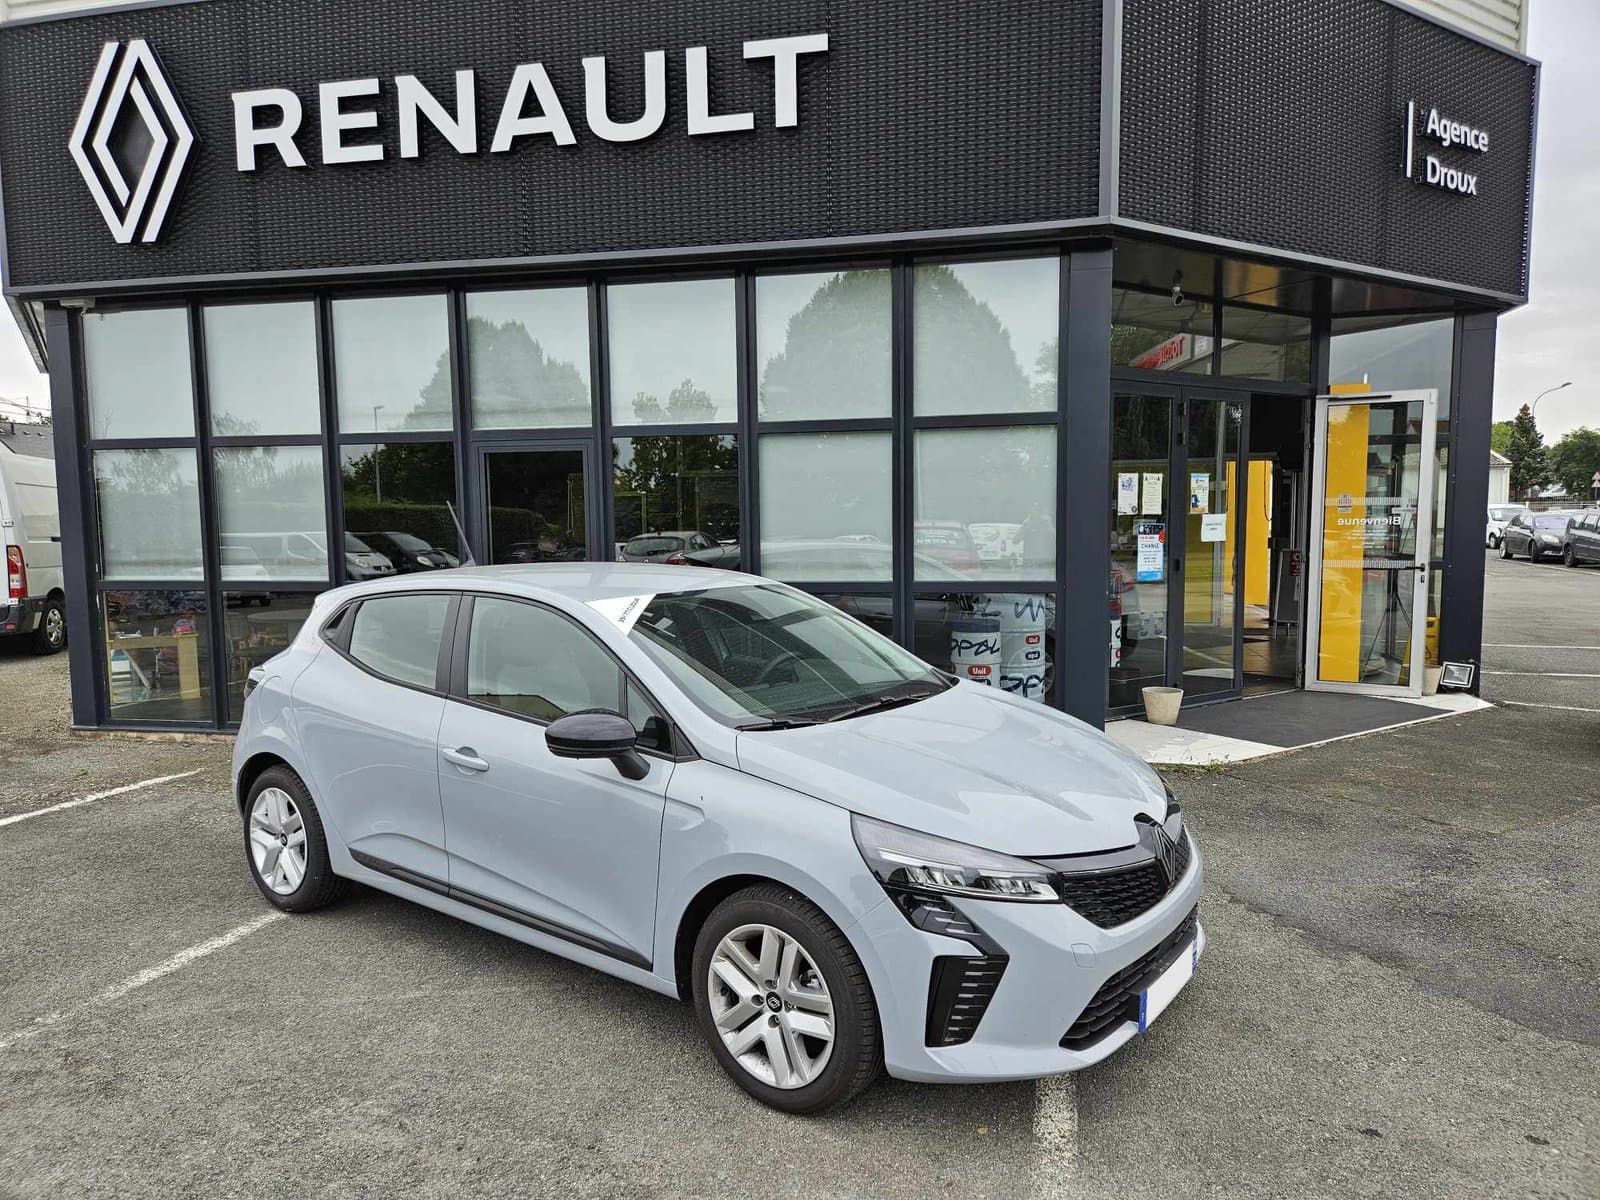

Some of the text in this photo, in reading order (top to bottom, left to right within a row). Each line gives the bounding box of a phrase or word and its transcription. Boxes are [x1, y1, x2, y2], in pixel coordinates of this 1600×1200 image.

[232, 33, 829, 172] RENAULT
[1427, 108, 1489, 152] Agence
[1426, 156, 1478, 195] Droux
[972, 667, 986, 675] Unil
